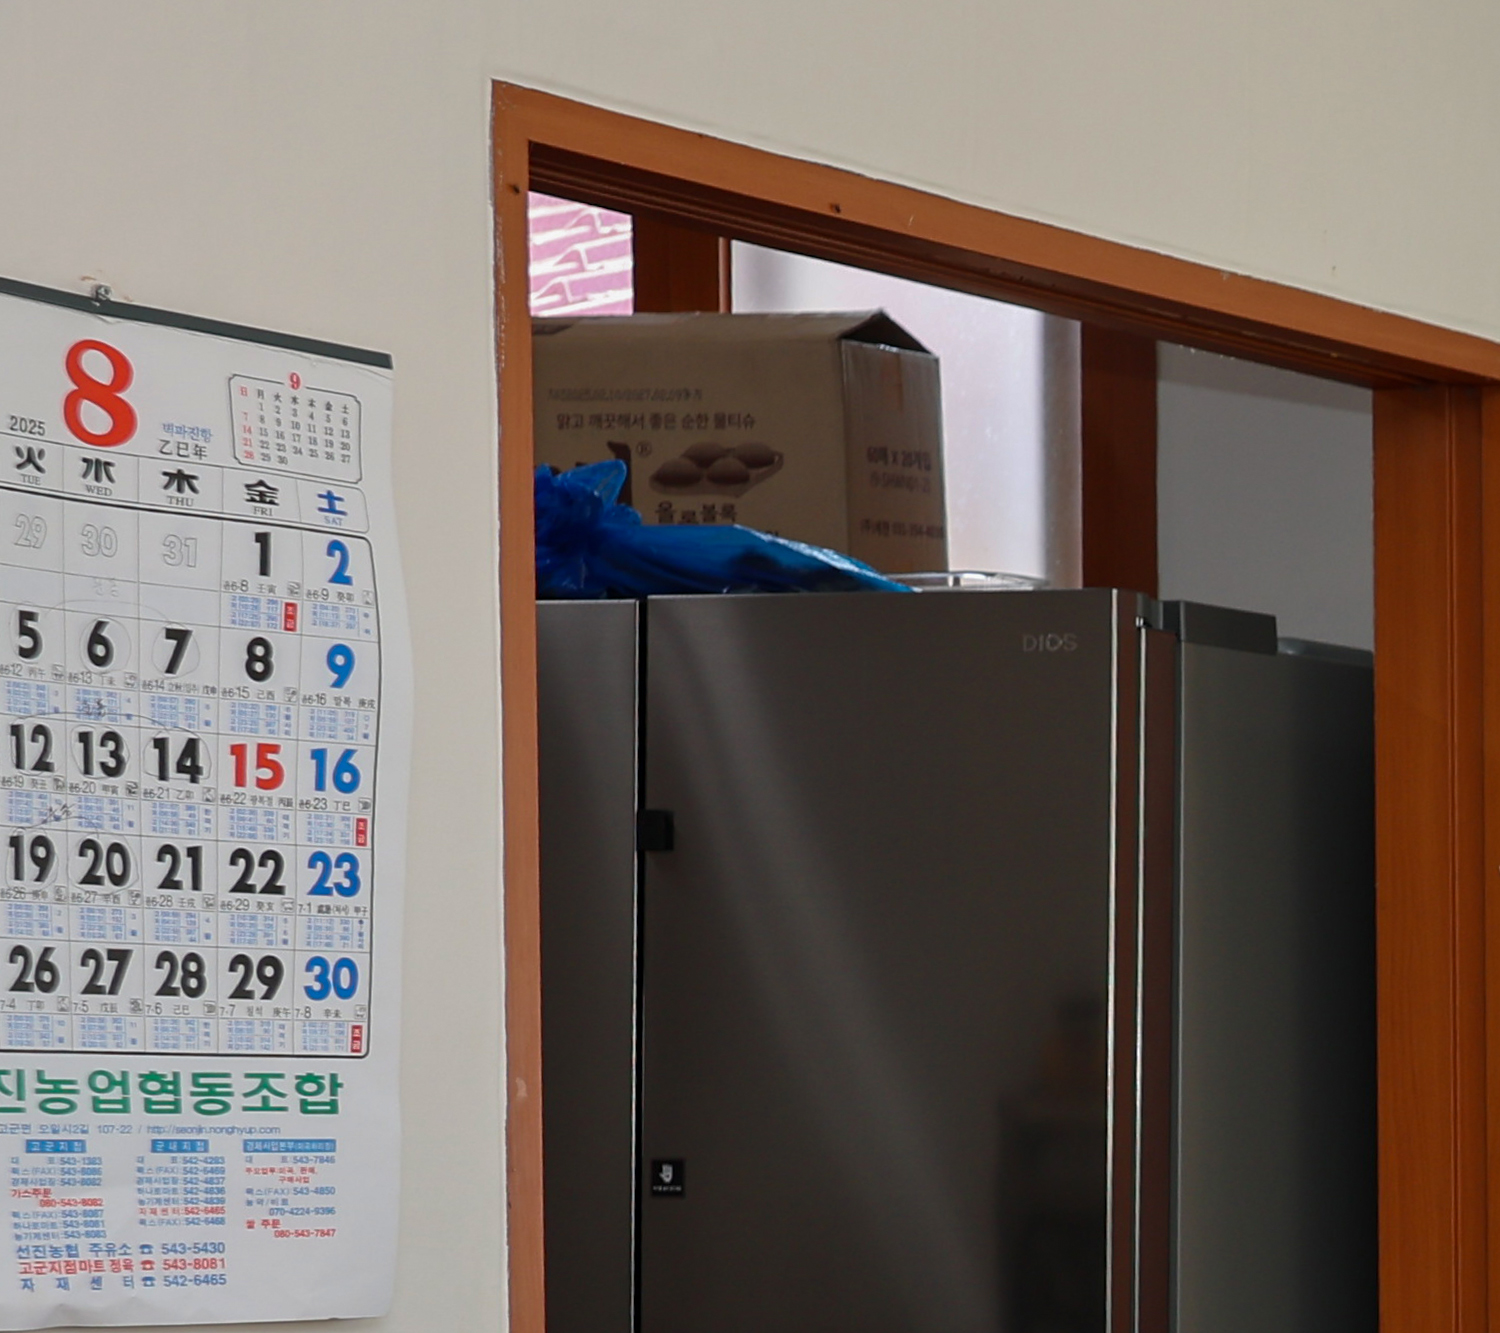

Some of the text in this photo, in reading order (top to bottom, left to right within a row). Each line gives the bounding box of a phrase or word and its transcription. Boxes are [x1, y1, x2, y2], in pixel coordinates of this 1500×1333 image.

[63, 339, 138, 447] 8
[290, 373, 300, 389] 9
[10, 416, 46, 436] 2025
[557, 413, 585, 430] 맑고
[588, 413, 644, 431] 깨끗해서
[649, 413, 676, 430] 좋은
[713, 412, 756, 430] 물티슈
[15, 446, 46, 474] 火
[82, 458, 116, 483] 水
[159, 440, 208, 460] 乙巳年
[20, 474, 41, 485] TUE
[86, 485, 113, 496] WED
[162, 469, 199, 494] 木
[167, 496, 194, 507] THU
[244, 480, 279, 506] 金
[253, 506, 273, 516] FRI
[317, 490, 347, 515] 土
[324, 516, 343, 526] SAT
[14, 513, 47, 549] 29
[81, 524, 118, 558] 30
[162, 534, 197, 568] 31
[255, 532, 271, 577] 1
[327, 539, 353, 586] 2
[18, 610, 43, 659] 5
[87, 620, 114, 668] 6
[164, 627, 193, 674] 7
[1022, 634, 1078, 654] DIOS
[245, 637, 274, 682] 8
[326, 643, 356, 689] 9
[10, 724, 55, 772] 12
[78, 731, 127, 778] 13
[153, 737, 204, 784] 14
[230, 743, 285, 790] 15
[310, 748, 361, 794] 16
[9, 835, 56, 882] 19
[78, 838, 131, 886] 20
[157, 844, 203, 891] 21
[228, 848, 286, 895] 22
[307, 850, 362, 897] 23
[8, 945, 60, 994] 26
[80, 948, 134, 996] 27
[155, 950, 207, 999] 28
[228, 953, 284, 1000] 29
[304, 956, 359, 1001] 30
[17, 1242, 225, 1259] 선진농협 주유소 543-5430
[18, 1259, 106, 1275] 고군지점마트
[163, 1258, 225, 1270] 543-8081
[164, 1274, 227, 1287] 542-6465
